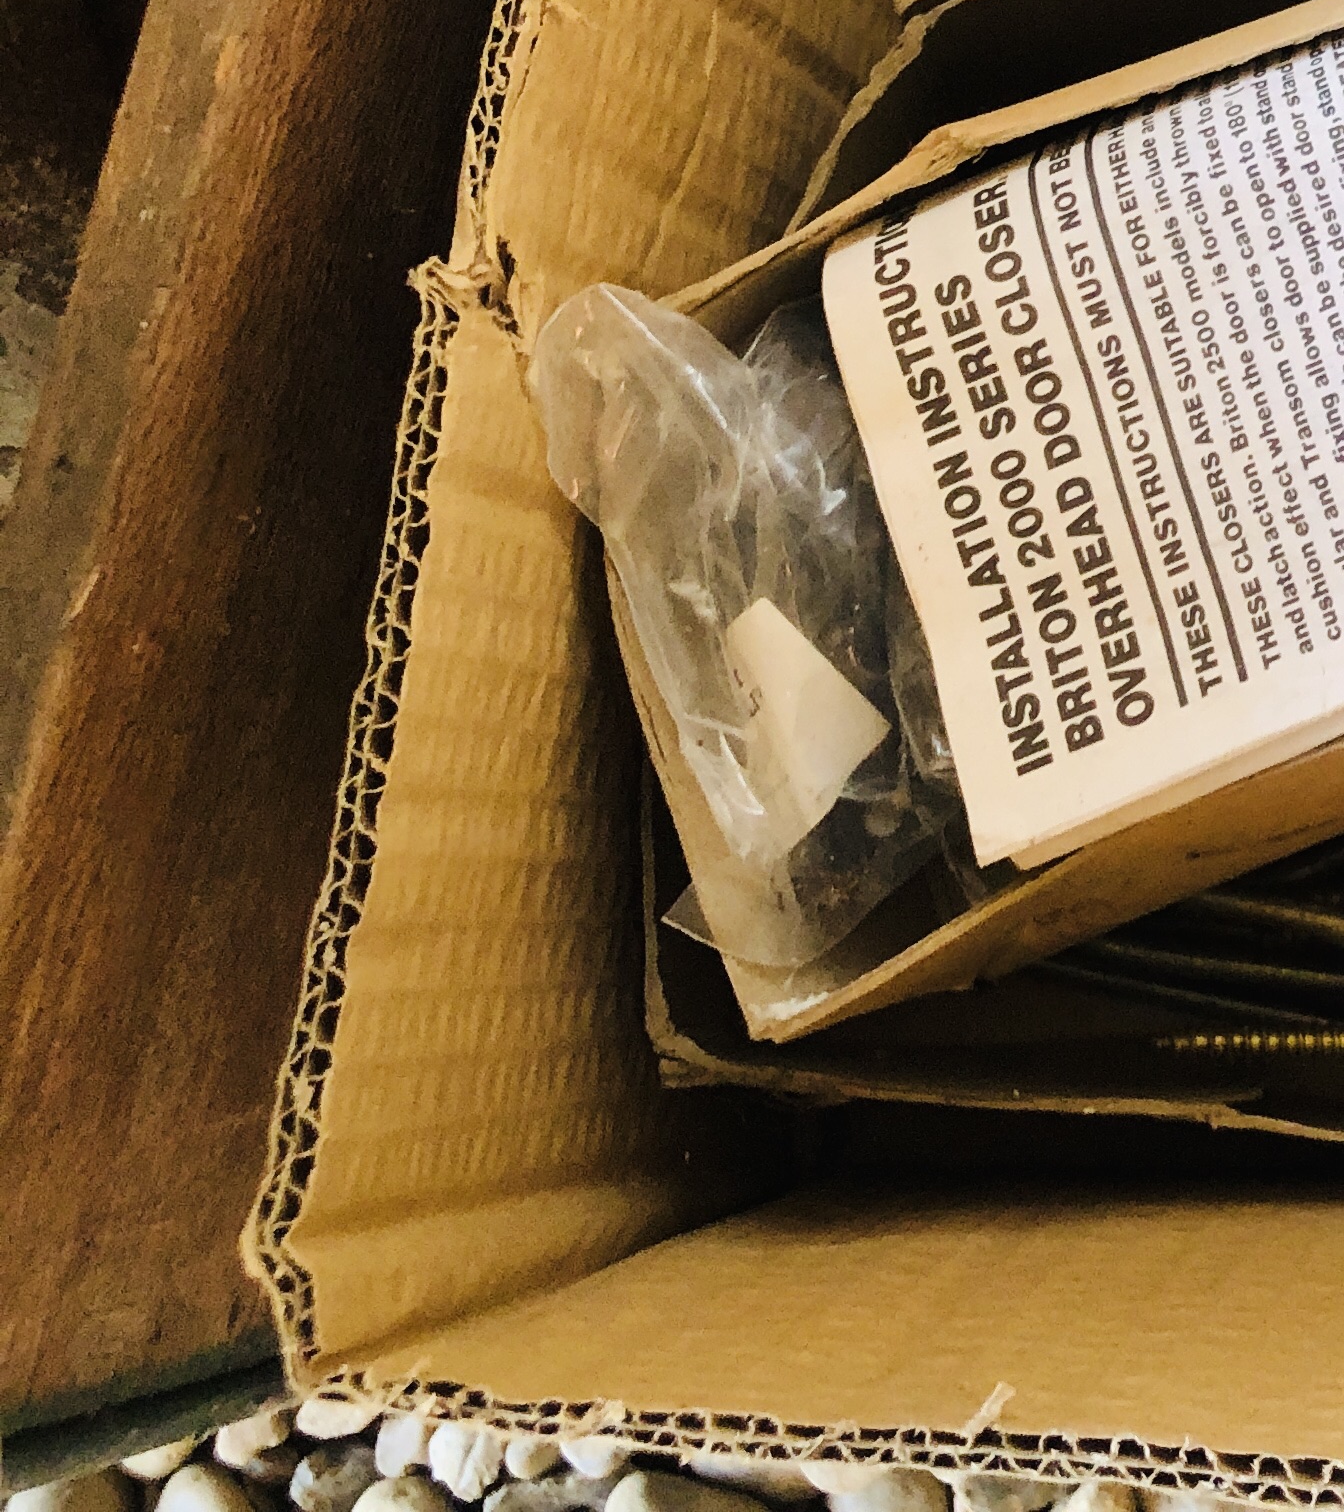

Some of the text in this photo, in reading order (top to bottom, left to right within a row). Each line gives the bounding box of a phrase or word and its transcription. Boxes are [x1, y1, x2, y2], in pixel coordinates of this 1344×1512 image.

[1238, 139, 1256, 164] to
[1245, 162, 1275, 222] open
[1266, 224, 1285, 251] to
[1274, 255, 1303, 307] door
[1305, 65, 1336, 118] stand
[867, 208, 1054, 777] INSTALLATION INSTRUCTIO
[933, 273, 1105, 753] BRITON 2000 SERIES
[962, 174, 1155, 727] OVERHEAD DOOR CLOSER.
[1042, 142, 1223, 698] THESE INSTRUCTIONS MUST NOT BE
[1106, 137, 1281, 670] THESE CLOSERS ARE SUITABLE FOR EITHER
[1138, 136, 1314, 654] and latch action. Briton 2500 models include
[1160, 102, 1342, 641] cushion effect when the door is forcibly thrown
[1294, 310, 1330, 388] allows
